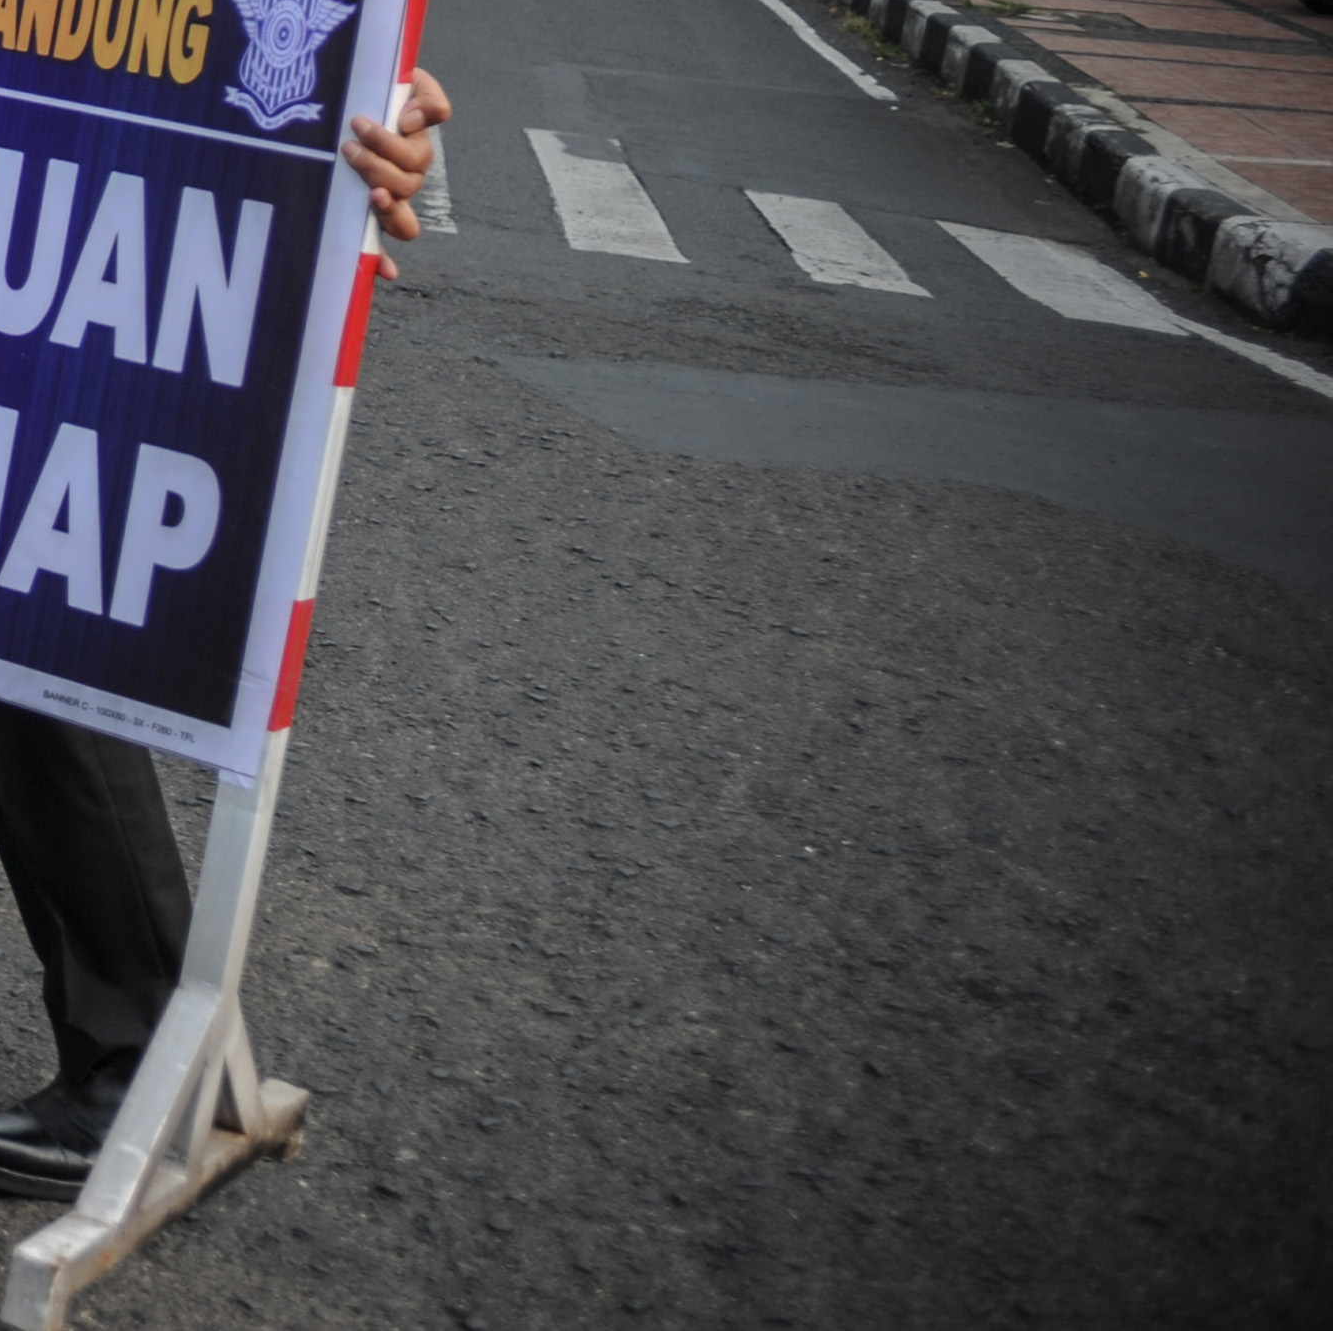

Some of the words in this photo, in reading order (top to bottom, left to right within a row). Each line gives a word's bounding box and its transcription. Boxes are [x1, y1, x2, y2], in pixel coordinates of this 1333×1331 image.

[43, 689, 79, 708] BANNER
[81, 702, 89, 711] C
[180, 731, 195, 743] TFL
